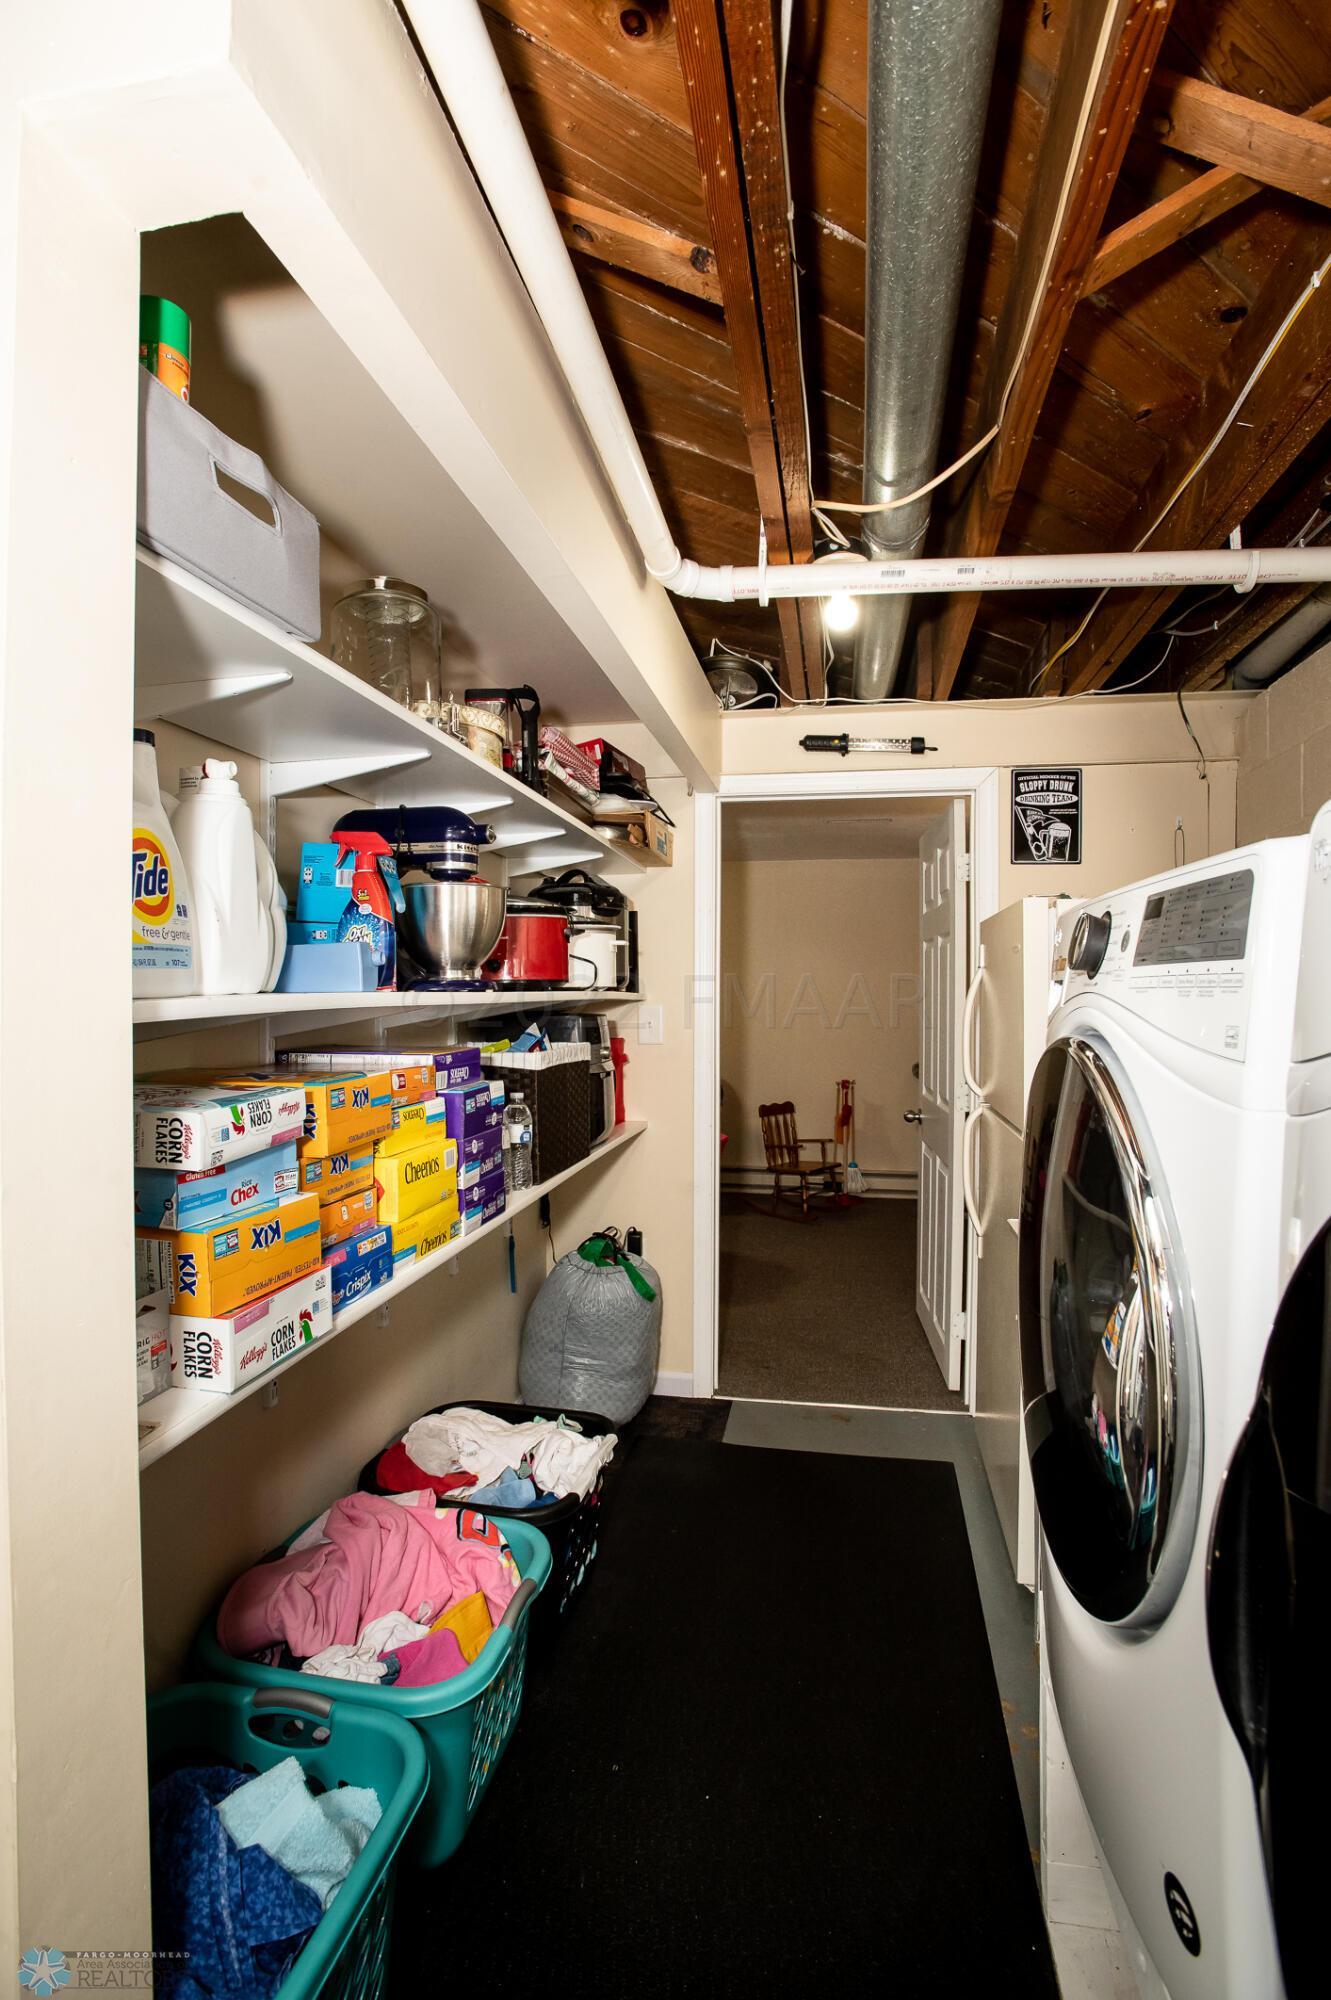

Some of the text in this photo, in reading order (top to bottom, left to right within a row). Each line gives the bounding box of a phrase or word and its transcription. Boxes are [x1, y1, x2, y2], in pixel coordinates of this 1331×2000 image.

[1019, 780, 1075, 793] SLOPPY DRUNK
[1019, 793, 1074, 804] DRINKING TEAM
[132, 852, 169, 905] Tide
[141, 926, 191, 941] free & gentle
[247, 1099, 271, 1114] FLAKES
[249, 1110, 272, 1128] CORN
[402, 1107, 425, 1122] Cheerios
[155, 1117, 168, 1165] FLAKES
[168, 1117, 183, 1164] CORN
[185, 1168, 216, 1181] Gluten Free
[241, 1178, 252, 1188] Rice
[404, 1157, 440, 1185] Cheerios
[230, 1183, 259, 1206] Chex
[420, 1230, 447, 1257] Cheerios
[345, 1269, 372, 1297] Crispix
[270, 1320, 295, 1347] CORN
[183, 1330, 197, 1380] FLAKES
[196, 1331, 213, 1379] CORN
[239, 1341, 268, 1370] Kellogg's
[271, 1335, 297, 1361] FLAKES
